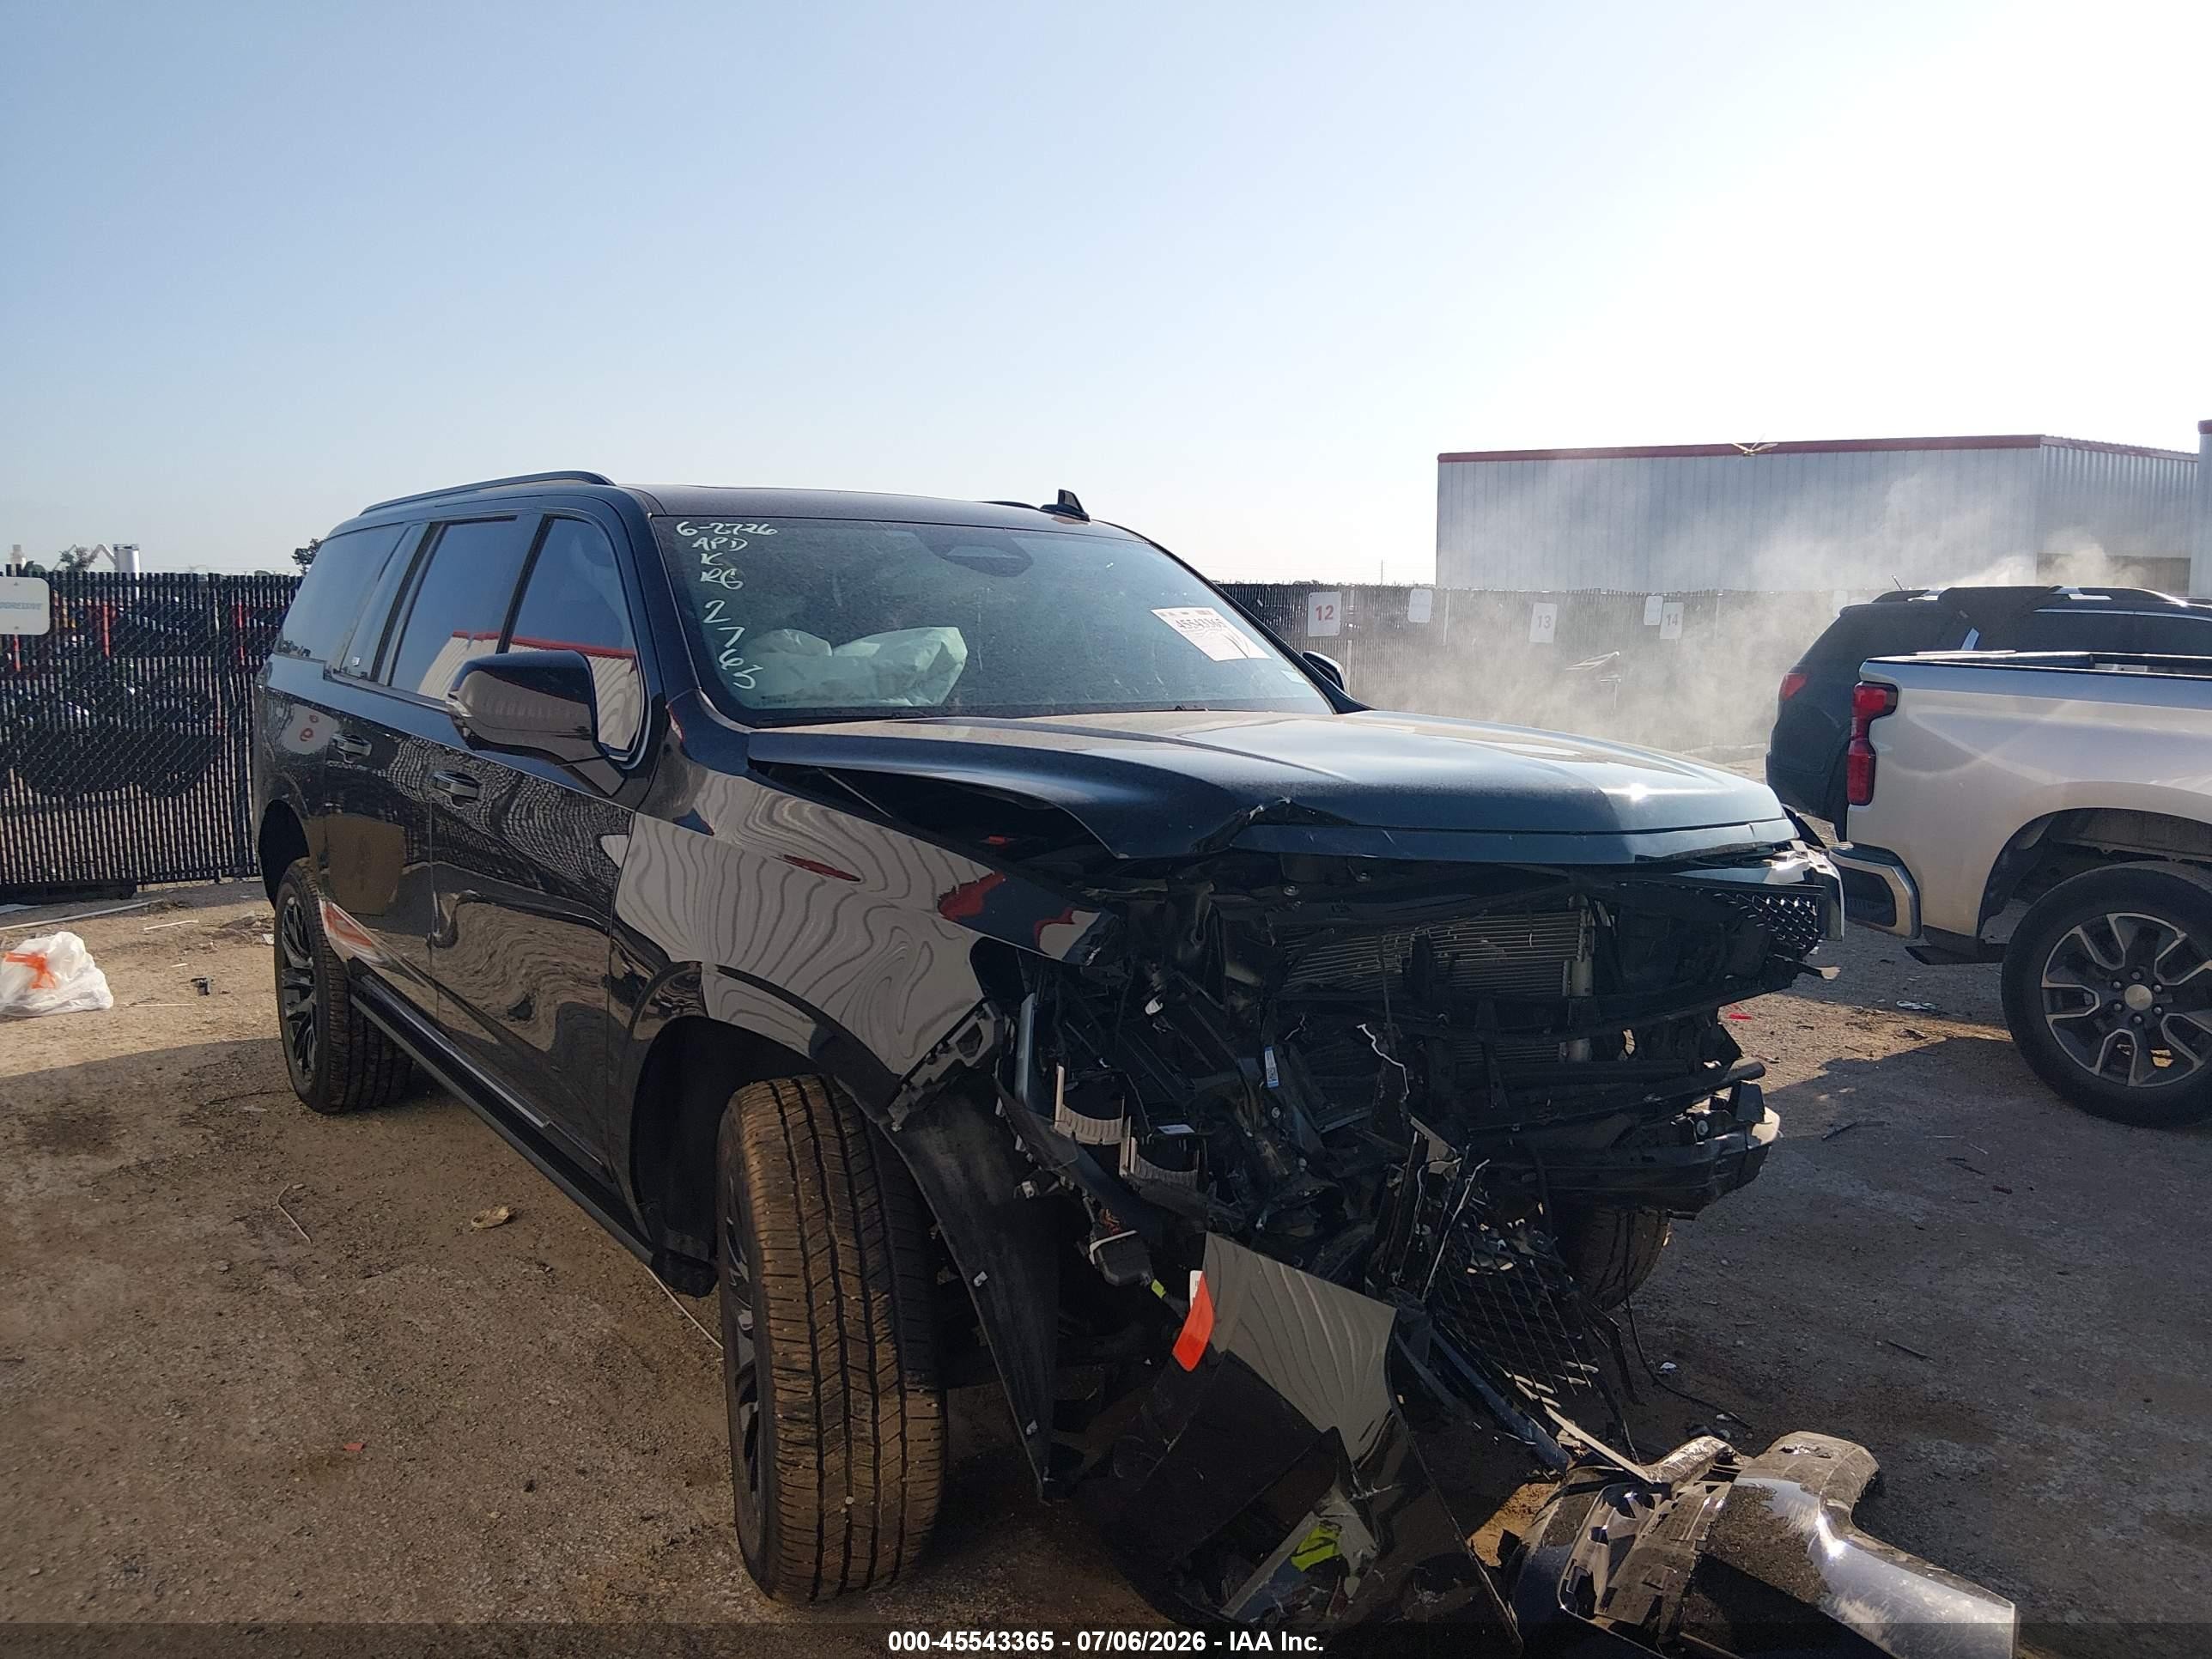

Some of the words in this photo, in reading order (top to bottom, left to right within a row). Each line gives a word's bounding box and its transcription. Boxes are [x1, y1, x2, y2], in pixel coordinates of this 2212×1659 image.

[692, 537, 748, 550] APD
[1315, 605, 1334, 621] 12
[1666, 613, 1679, 627] 14
[1537, 615, 1552, 629] 13
